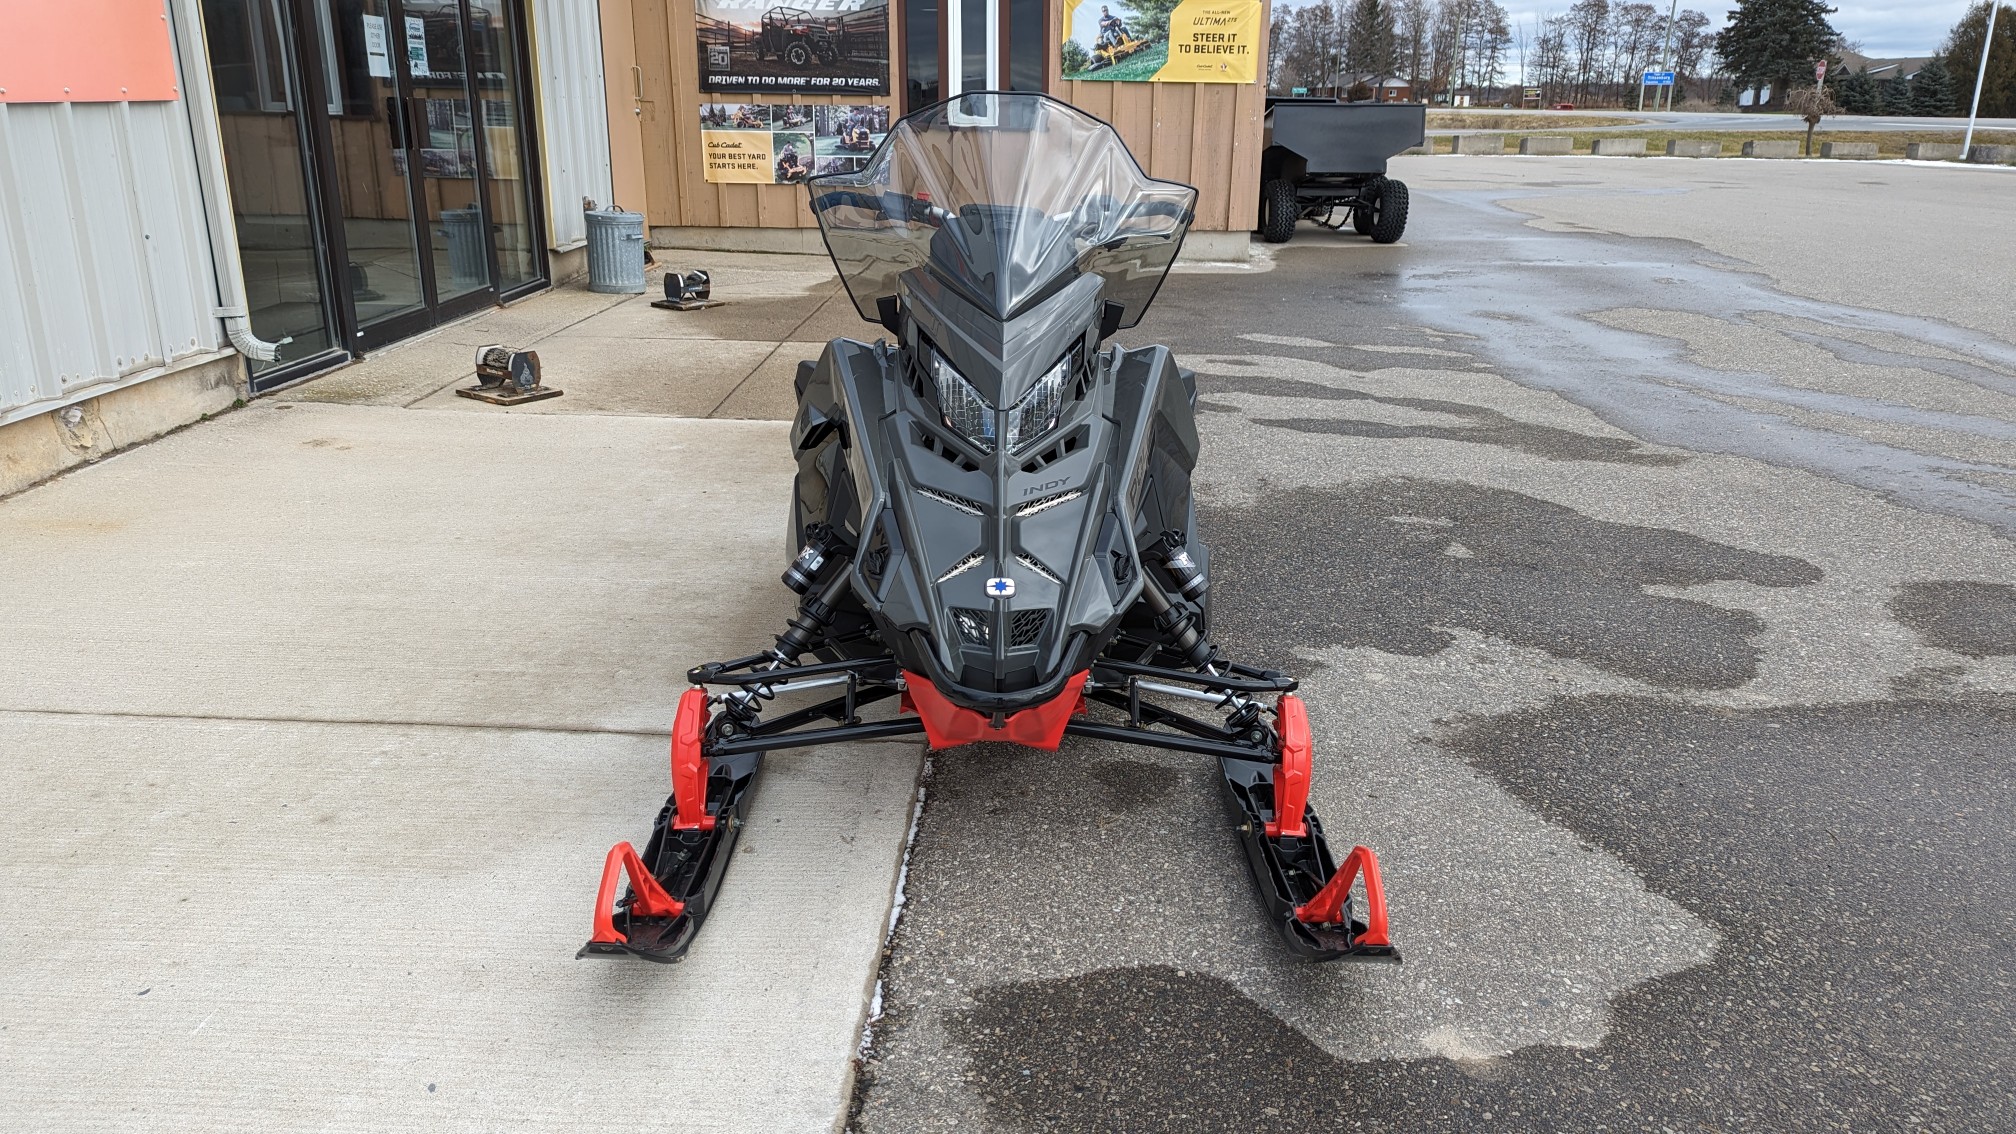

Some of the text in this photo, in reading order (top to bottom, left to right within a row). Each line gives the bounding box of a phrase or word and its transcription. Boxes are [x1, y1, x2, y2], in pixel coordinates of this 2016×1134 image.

[1193, 17, 1226, 26] ULTIMA
[1192, 32, 1238, 43] STEER IT
[1178, 44, 1250, 55] TO BELIEVE IT.
[710, 51, 728, 65] 20
[708, 75, 746, 85] DRIVEN
[747, 76, 760, 85] TO
[761, 76, 776, 85] DO
[811, 77, 831, 86] FOR
[831, 77, 846, 86] 20
[847, 78, 881, 87] YEARS.
[708, 152, 727, 160] YOUR
[728, 152, 746, 160] BEST
[709, 162, 759, 170] STARTS HERE.
[1023, 476, 1071, 496] INDY
